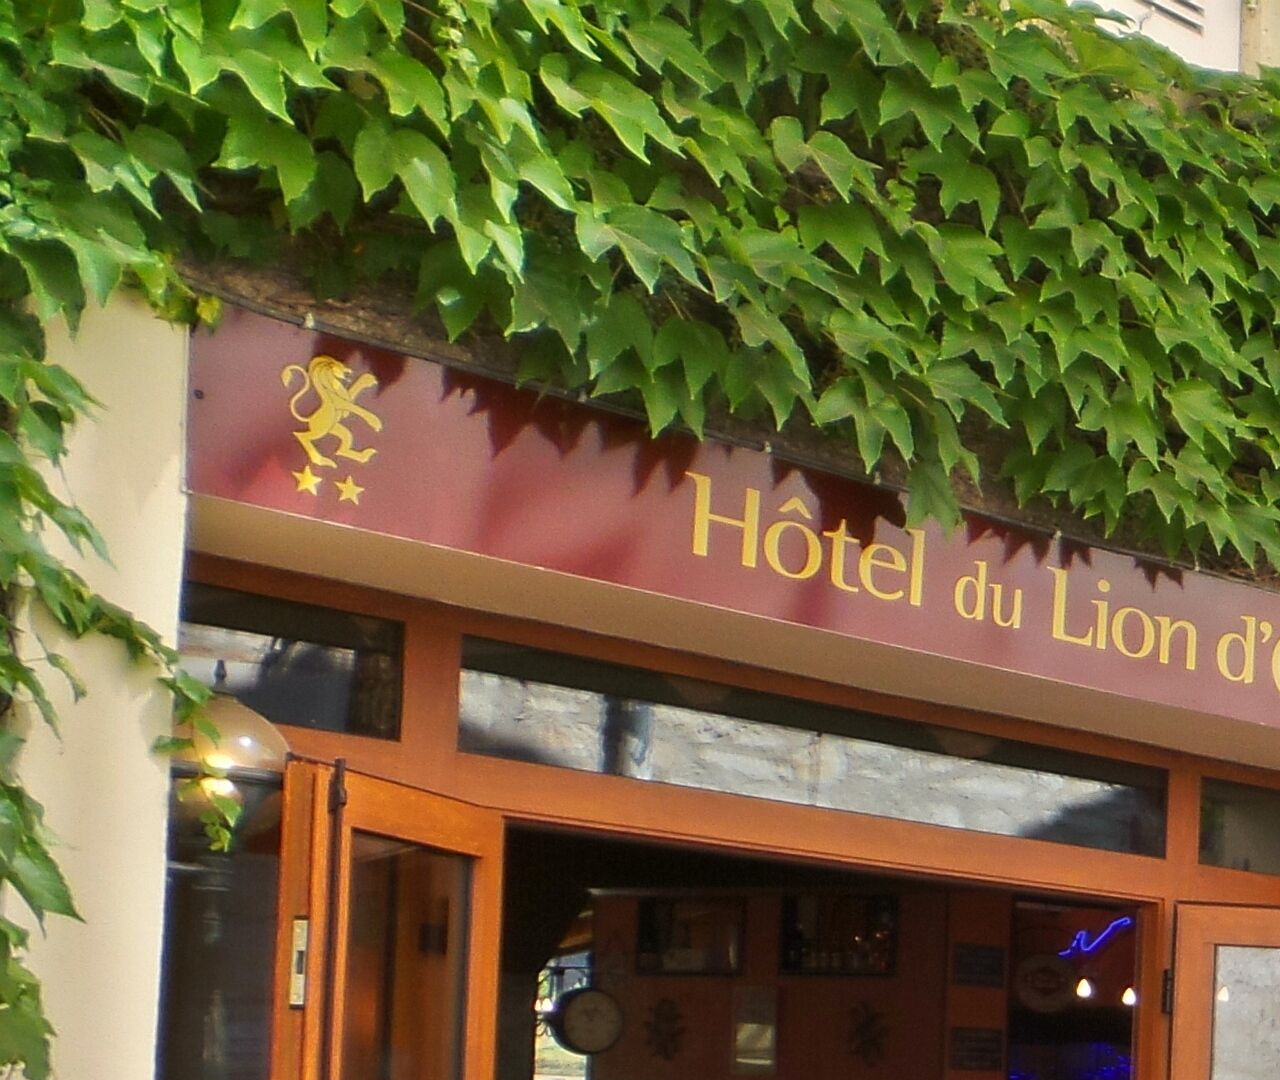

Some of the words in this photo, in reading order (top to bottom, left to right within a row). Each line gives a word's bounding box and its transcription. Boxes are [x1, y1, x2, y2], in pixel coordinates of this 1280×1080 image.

[685, 471, 926, 608] Hôtel
[954, 560, 1023, 630] du
[1046, 566, 1198, 672] Lion
